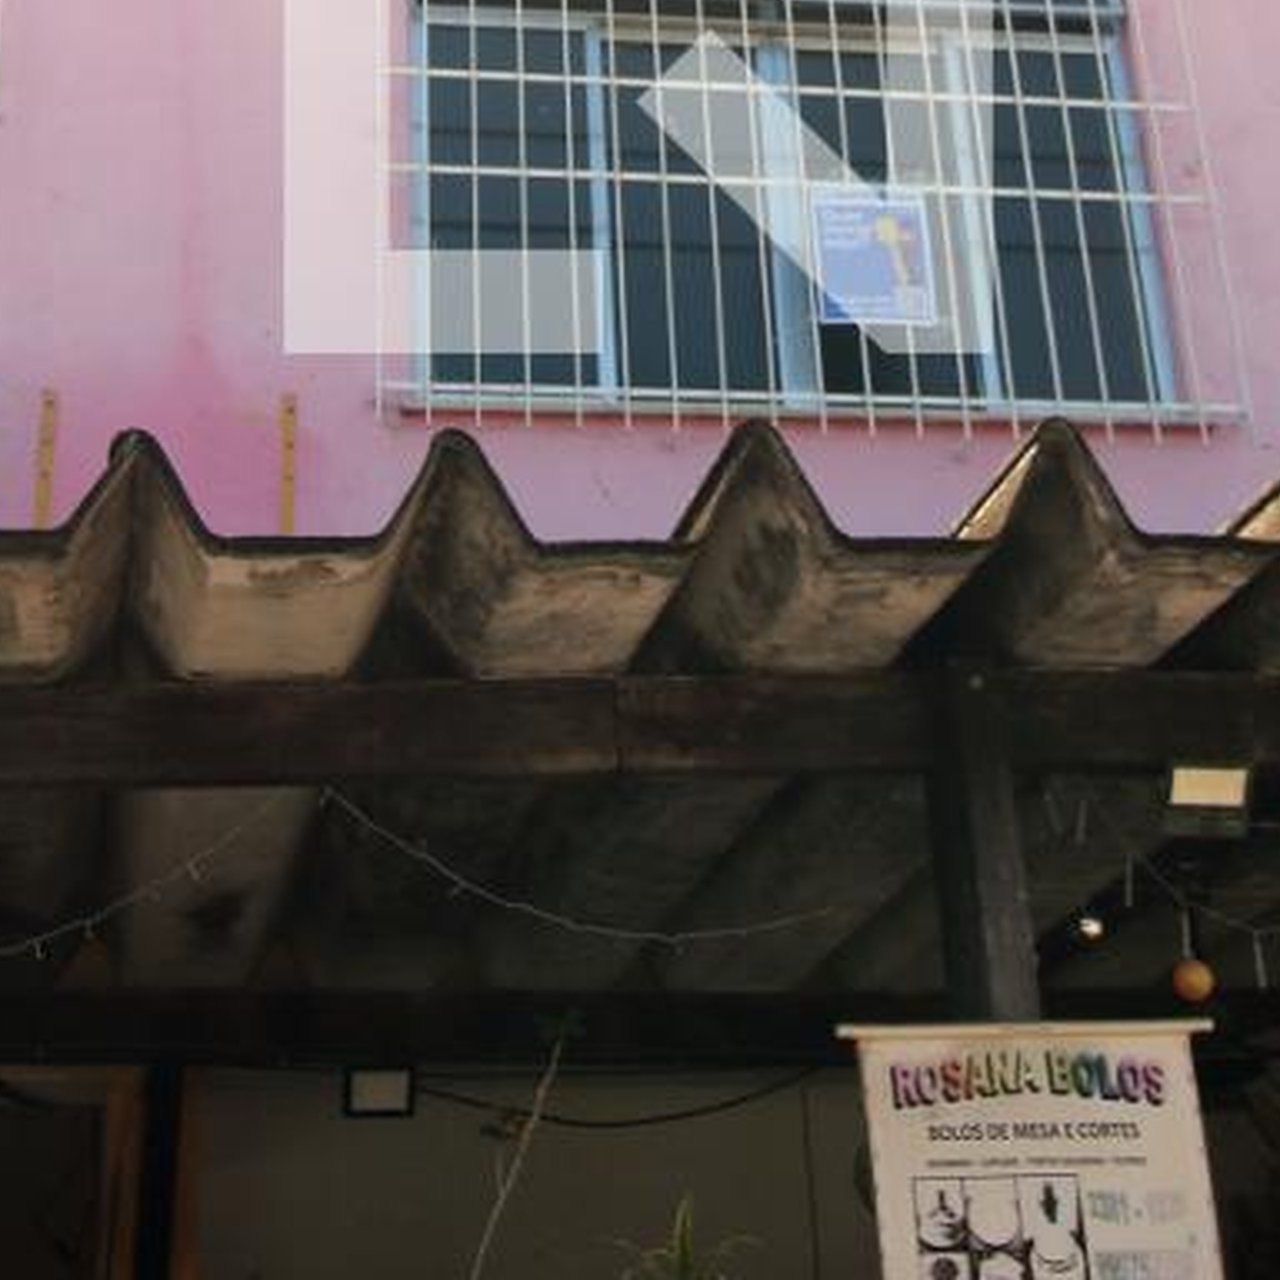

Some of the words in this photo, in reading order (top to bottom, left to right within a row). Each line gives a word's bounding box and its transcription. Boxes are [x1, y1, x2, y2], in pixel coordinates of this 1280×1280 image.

[890, 1051, 1040, 1110] ROSANA
[1044, 1050, 1164, 1107] BOLOS
[928, 1123, 984, 1142] BOLOS
[986, 1122, 1010, 1141] DE
[1013, 1122, 1061, 1140] MESA
[1064, 1122, 1076, 1140] E
[1077, 1121, 1141, 1140] CORTES
